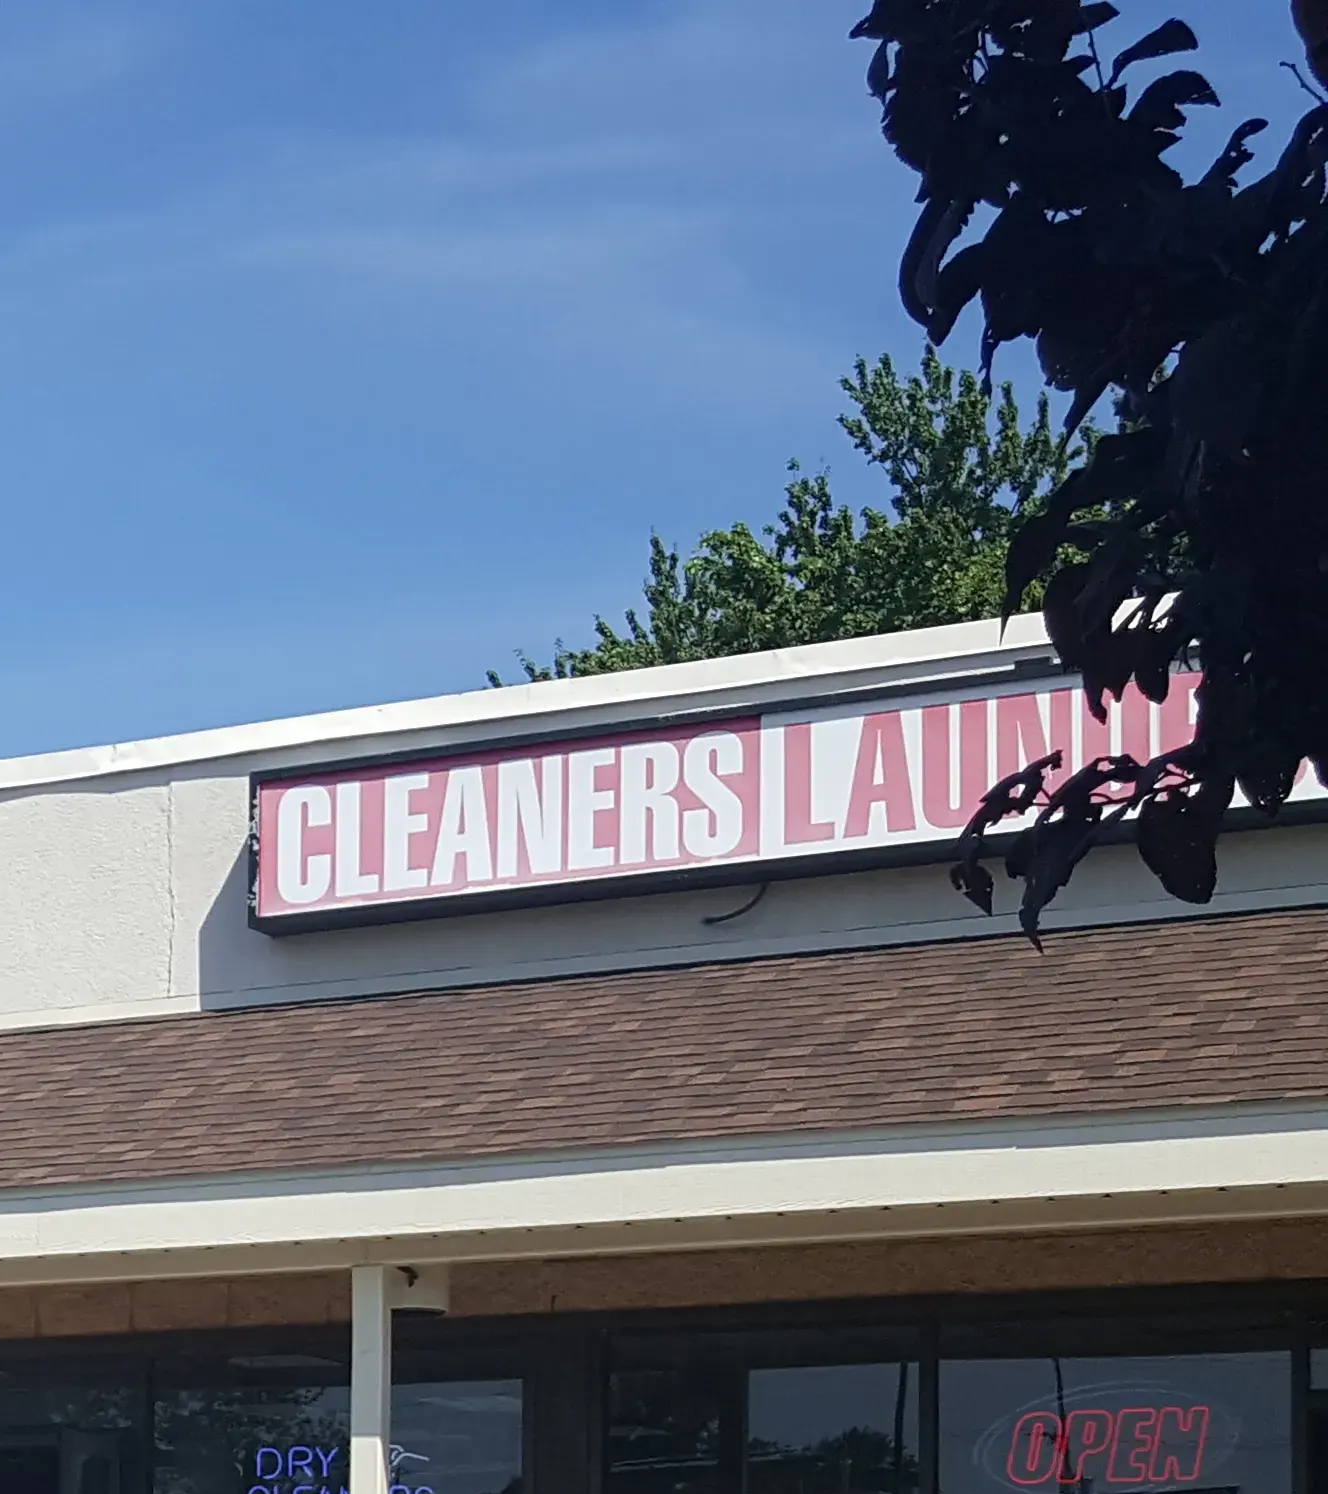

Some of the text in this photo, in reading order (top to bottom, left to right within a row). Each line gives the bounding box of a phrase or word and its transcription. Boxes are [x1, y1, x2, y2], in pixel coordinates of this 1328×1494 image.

[276, 731, 744, 904] CLEANERS
[256, 1445, 339, 1480] DRY
[1006, 1405, 1210, 1485] OPEN
